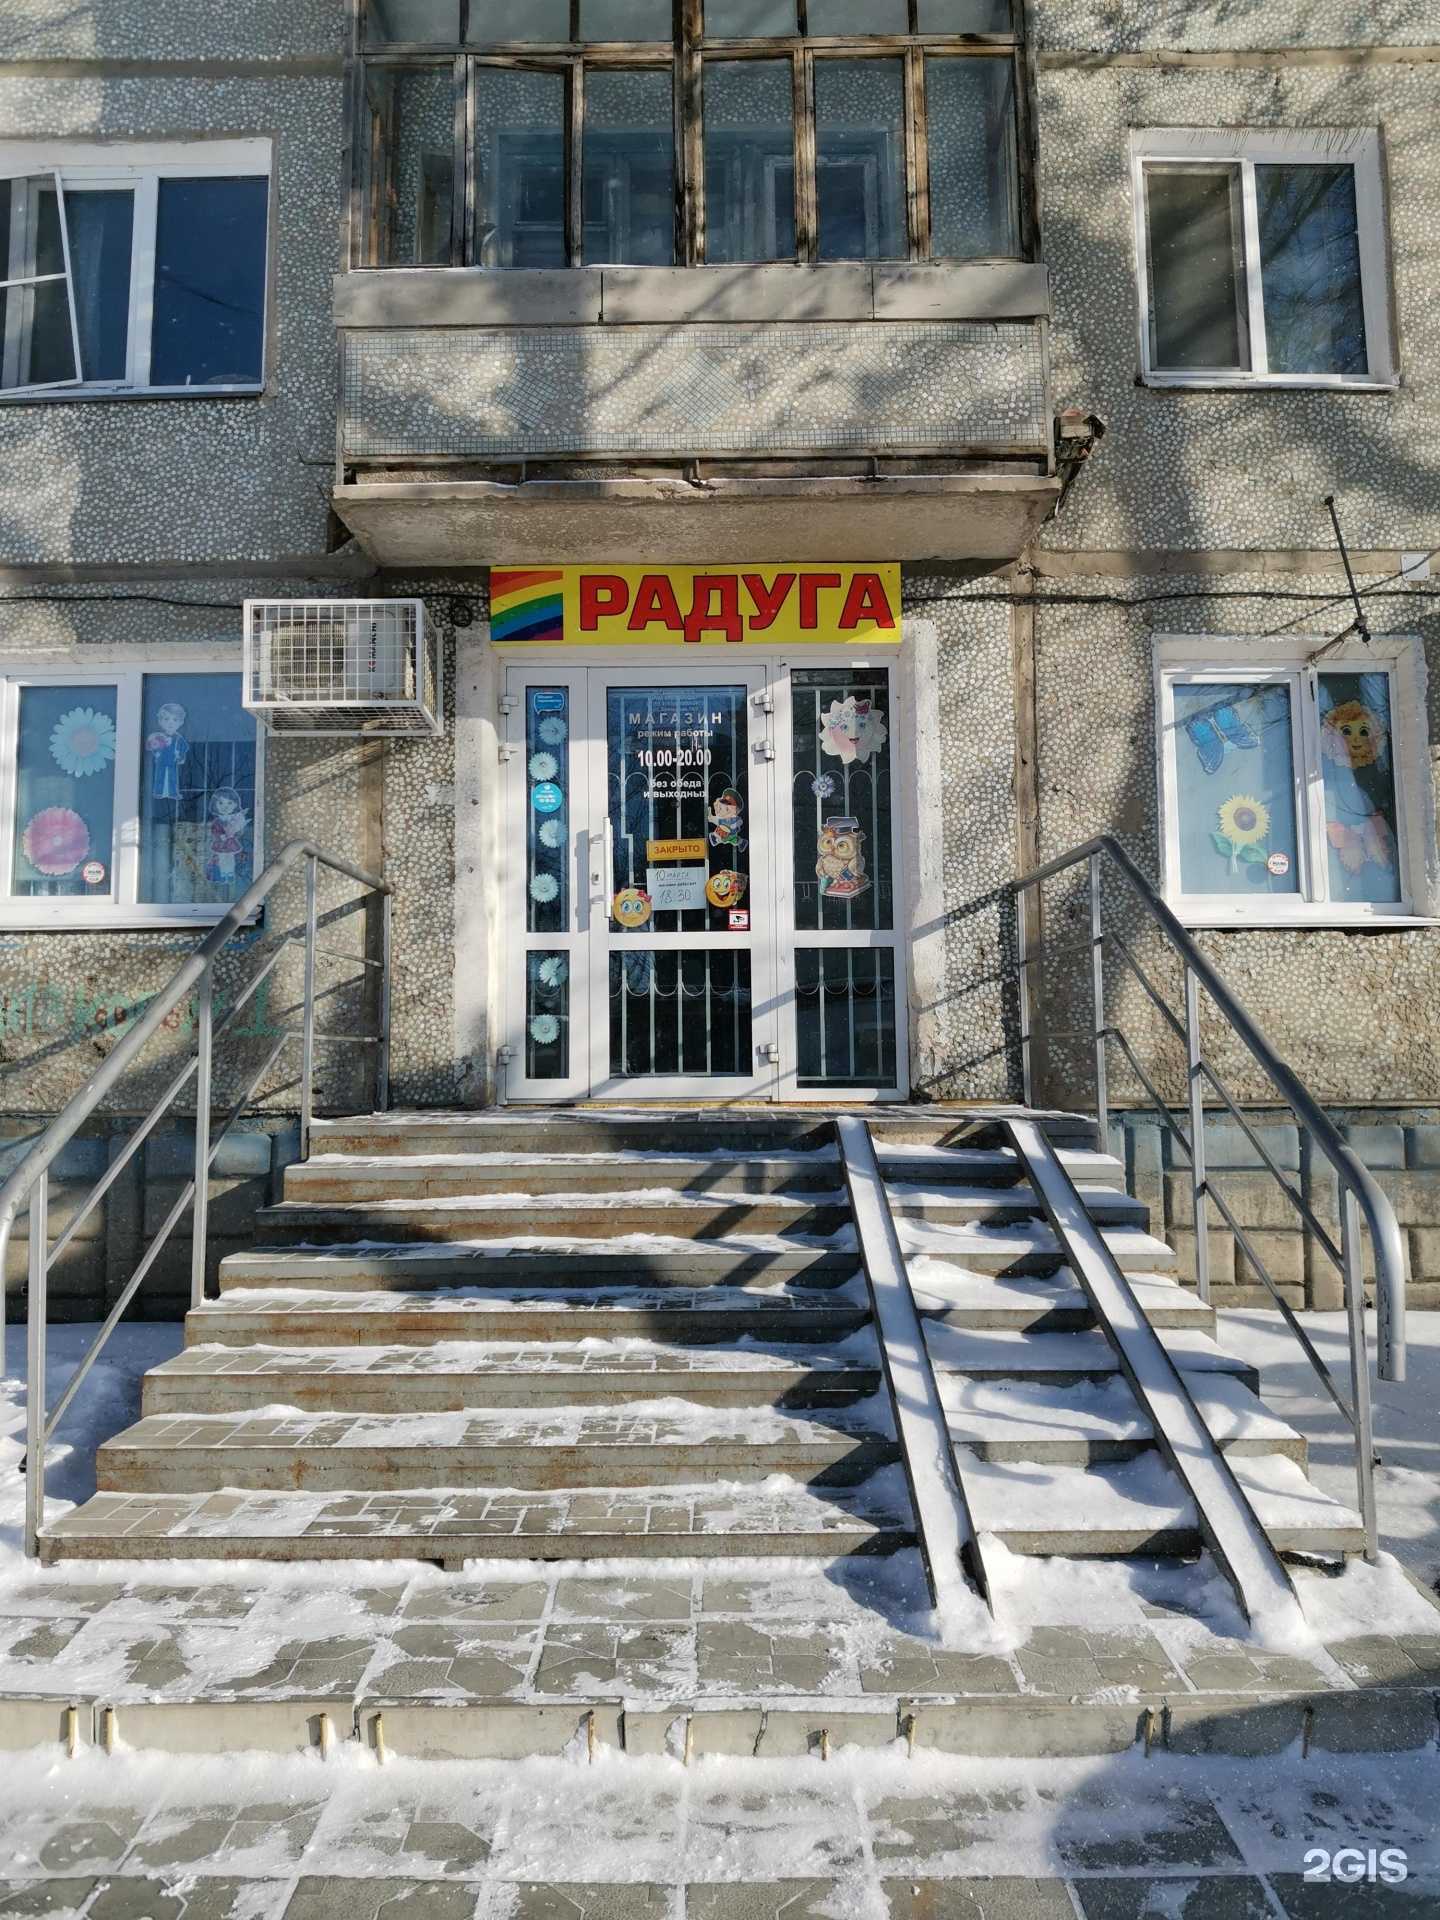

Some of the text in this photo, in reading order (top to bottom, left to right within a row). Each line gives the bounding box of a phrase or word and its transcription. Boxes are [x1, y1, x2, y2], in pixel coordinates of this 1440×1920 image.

[579, 573, 896, 642] РАДУГА
[629, 712, 722, 724] МАГАЗИН
[637, 749, 712, 767] 10.00-20.00
[650, 779, 702, 788] без обеда
[653, 791, 707, 799] выходных
[654, 845, 700, 854] ЗАКРЫТО
